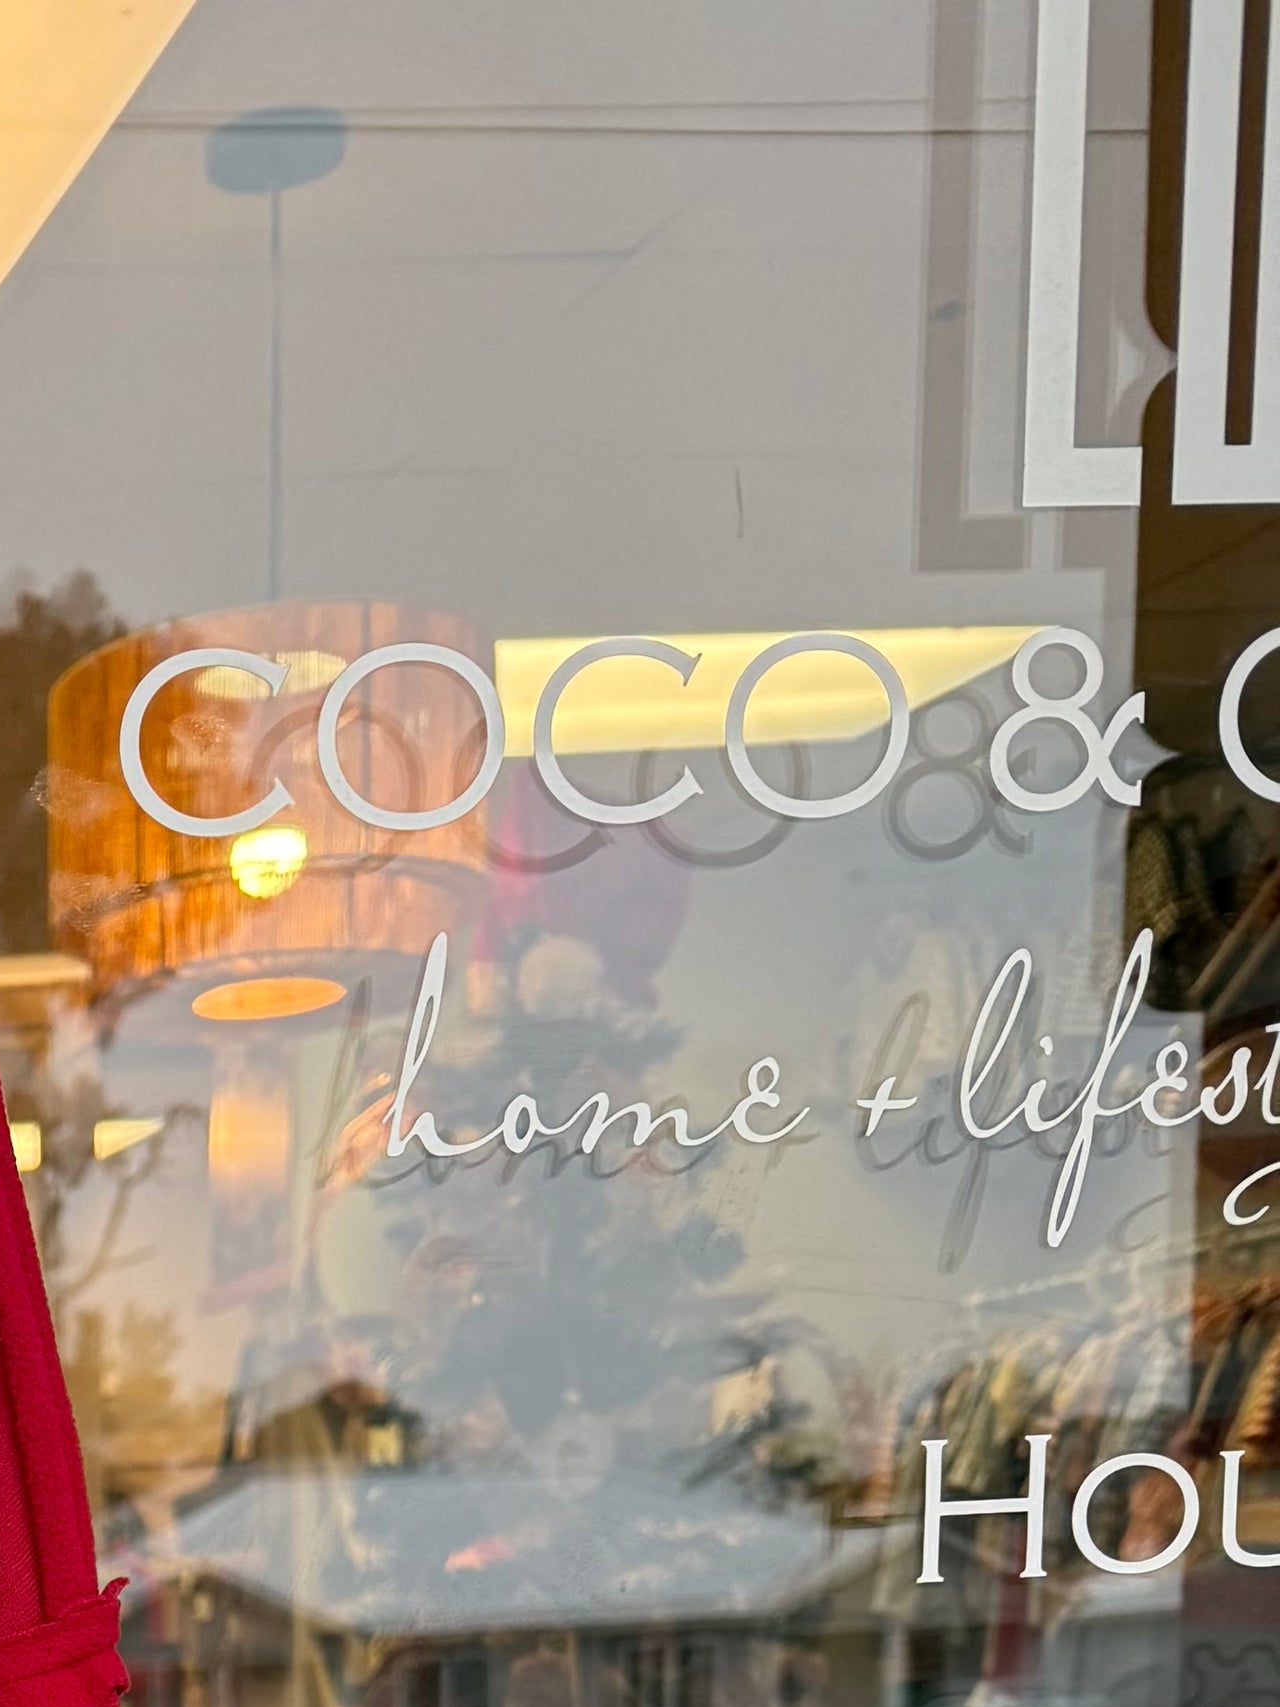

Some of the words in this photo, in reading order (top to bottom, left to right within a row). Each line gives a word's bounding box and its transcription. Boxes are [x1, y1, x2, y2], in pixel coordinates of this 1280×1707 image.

[119, 632, 908, 837] COCO
[989, 626, 1146, 811] &
[381, 930, 813, 1158] home
